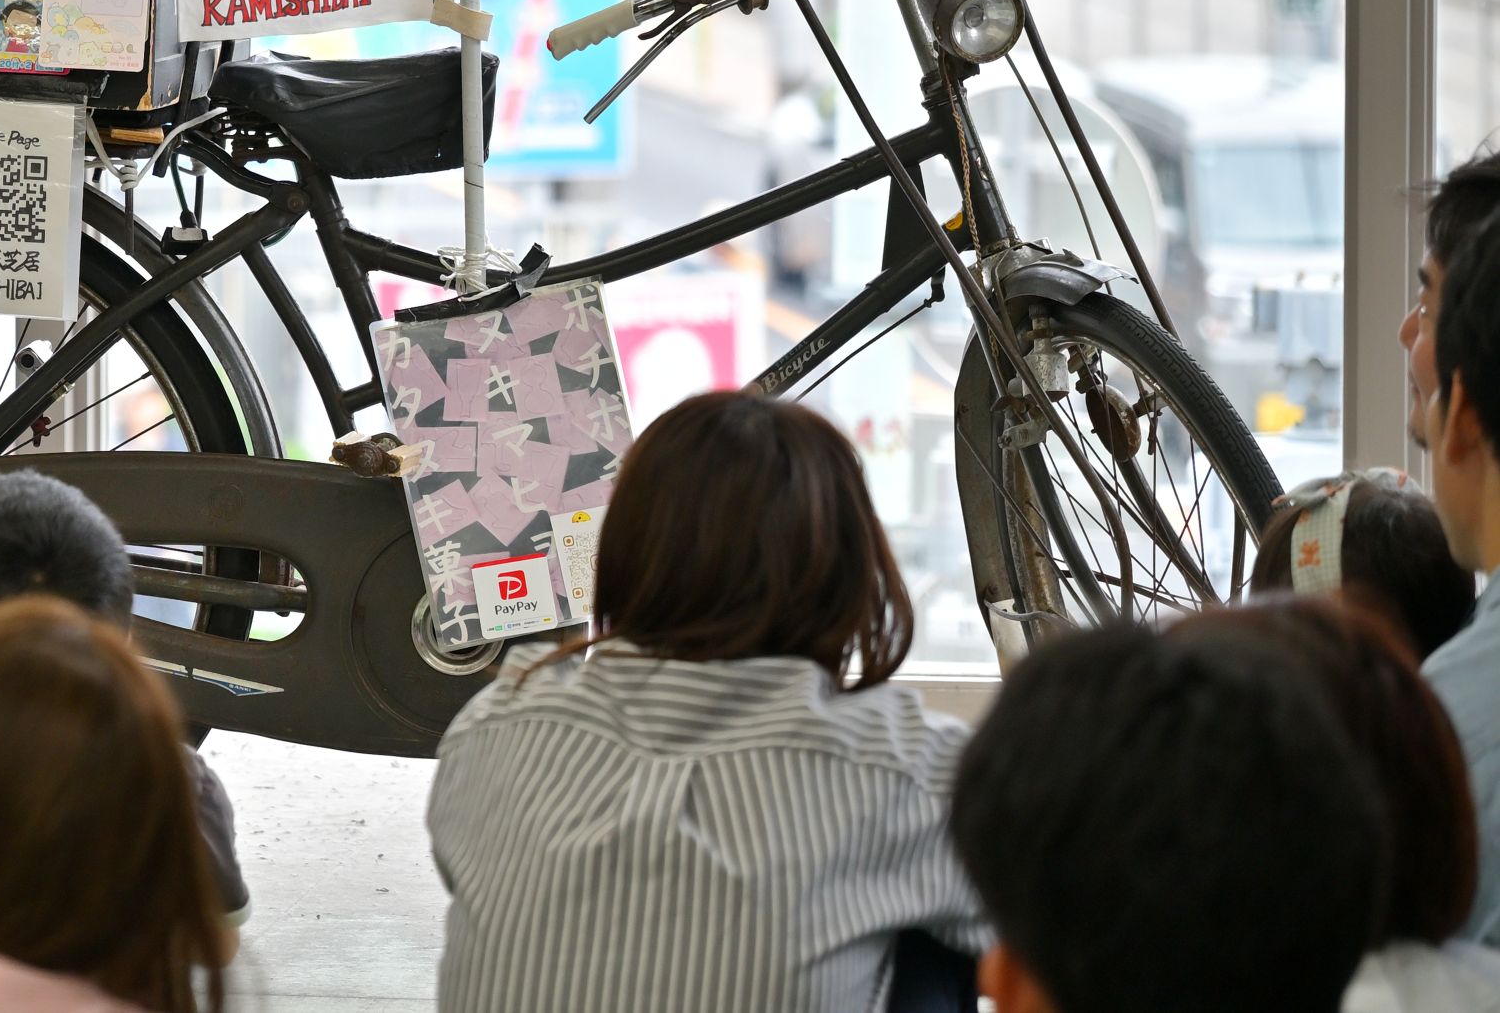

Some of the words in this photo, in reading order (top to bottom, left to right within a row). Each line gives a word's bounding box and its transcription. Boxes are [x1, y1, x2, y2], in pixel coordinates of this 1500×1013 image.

[7, 130, 41, 149] Page
[762, 338, 831, 393] Bicycle
[379, 331, 479, 645] カタヌキ菓子
[494, 600, 538, 616] PayPay
